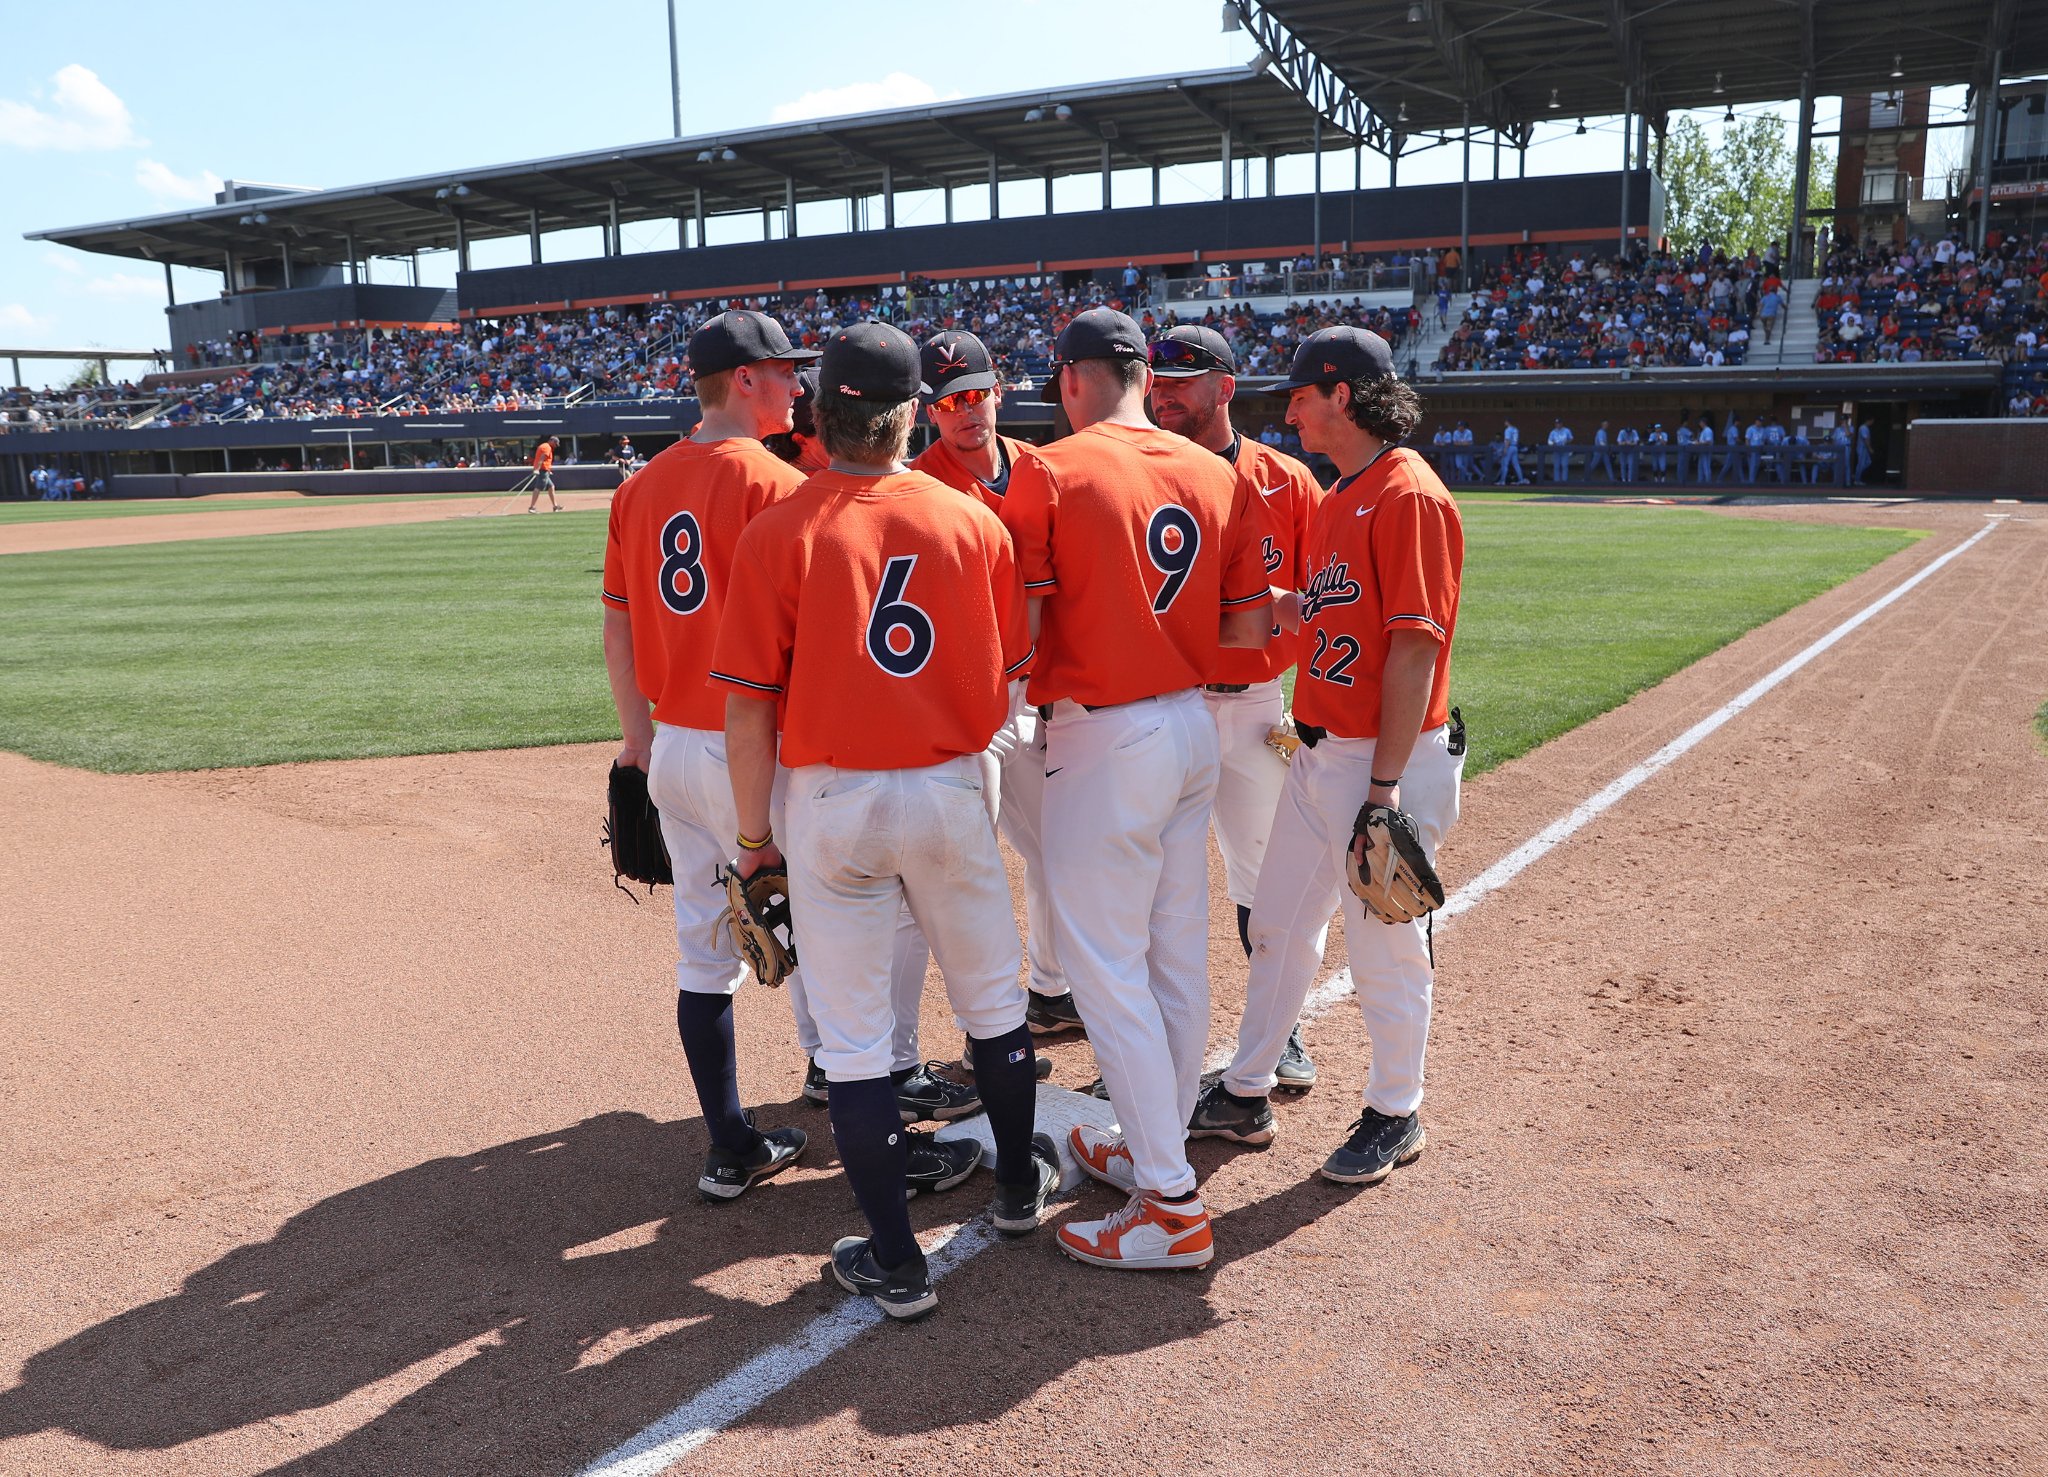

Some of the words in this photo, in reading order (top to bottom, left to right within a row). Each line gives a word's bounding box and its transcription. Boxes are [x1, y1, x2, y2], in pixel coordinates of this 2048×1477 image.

[1990, 183, 2037, 196] ATTLEFIELD
[839, 384, 862, 397] Hoos
[658, 510, 709, 616] 8
[1146, 503, 1202, 615] 9
[865, 554, 936, 678] 6
[1308, 627, 1361, 688] 22
